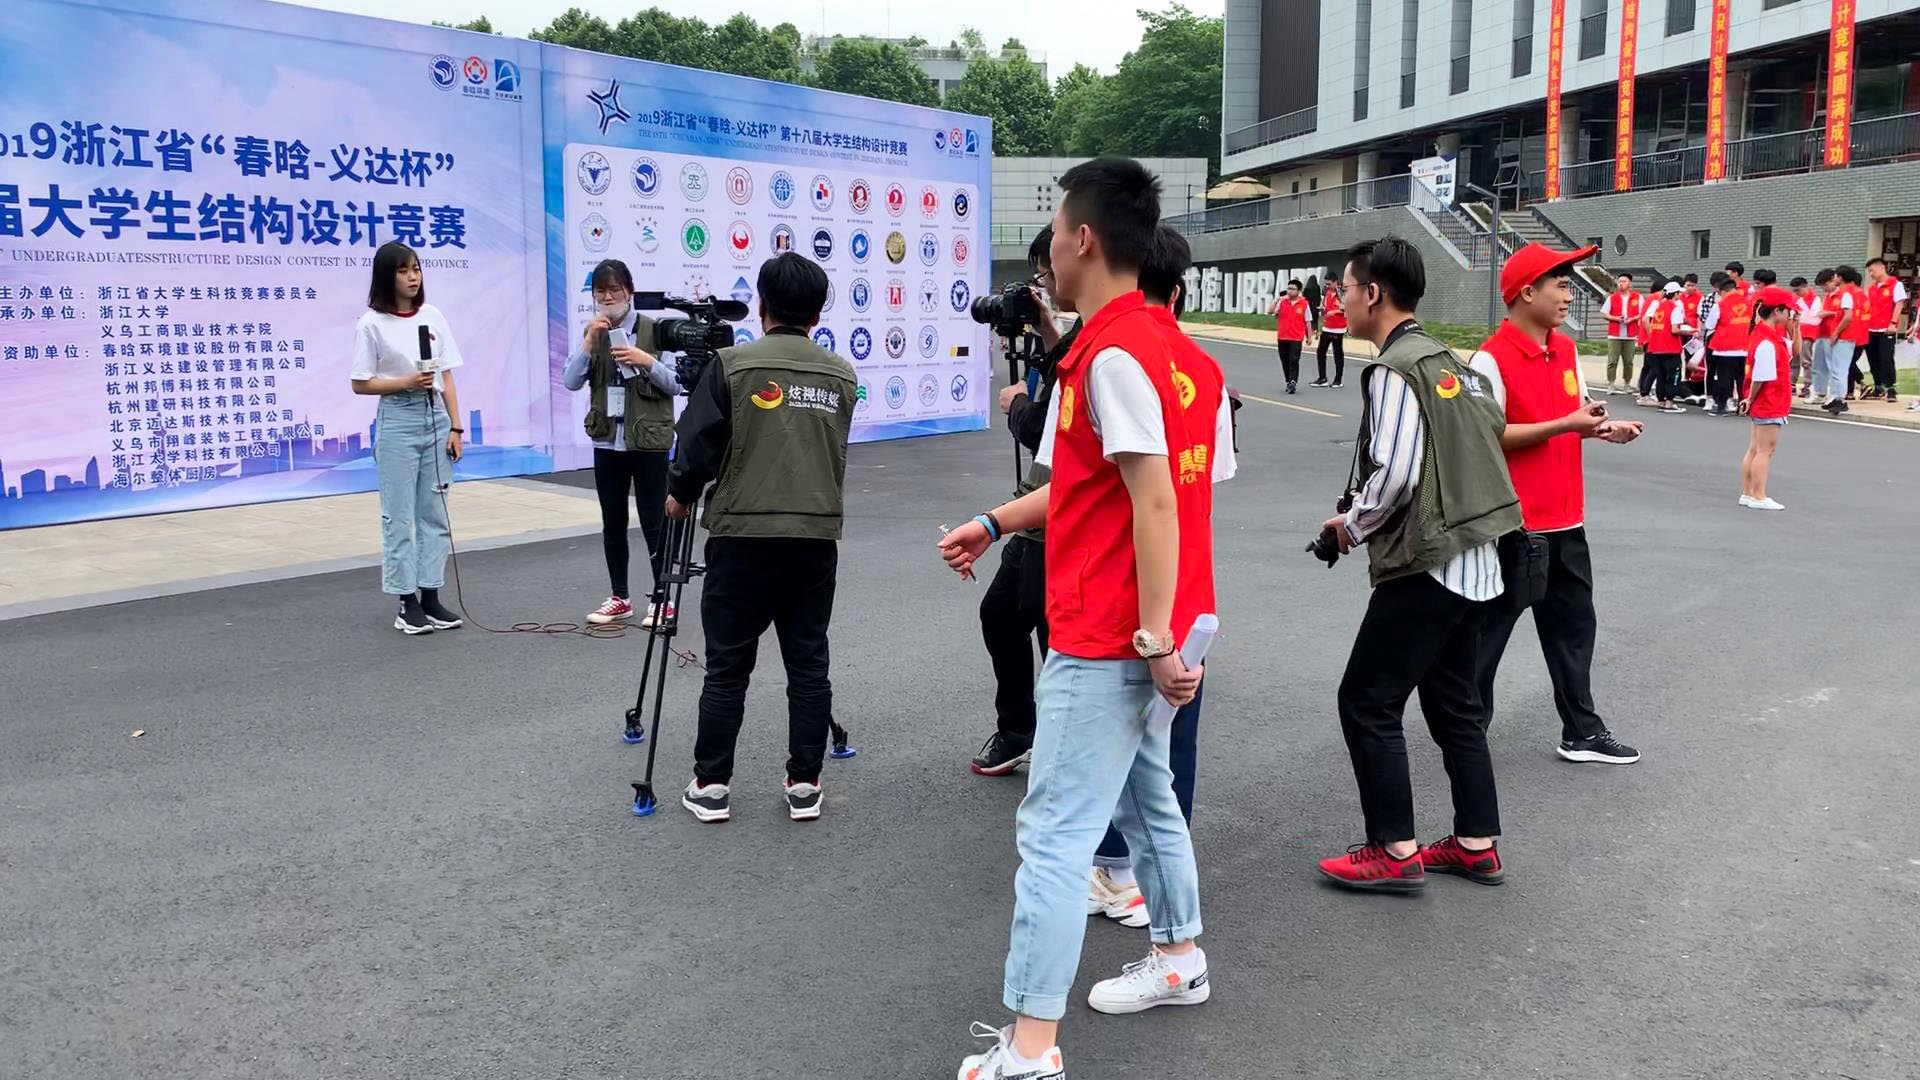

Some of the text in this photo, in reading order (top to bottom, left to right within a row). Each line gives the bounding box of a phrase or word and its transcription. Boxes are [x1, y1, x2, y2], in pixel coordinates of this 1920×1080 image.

[236, 255, 282, 266] DESIGN
[287, 256, 340, 267] CONTEST
[345, 257, 357, 267] IN
[421, 259, 469, 269] PROVINCE
[98, 286, 317, 300] 浙江省大学生科技竞赛委员会
[100, 305, 169, 319] 浙江大学
[101, 322, 273, 339] 义乌工商职业技术学院
[103, 339, 305, 358] 春晗环境建设股份有限公司
[104, 356, 307, 377] 浙江义达建设管理有限公司
[107, 375, 276, 396] 杭州邦博科技有限公司
[788, 385, 840, 407] 炫视传媒
[108, 393, 277, 415] 杭州建研科技有限公司
[110, 409, 294, 434] 北京迈达斯技术有限公司
[112, 424, 326, 452] 义乌市翔峰装饰工程有限公司
[113, 466, 217, 488] 海尔整体厨房
